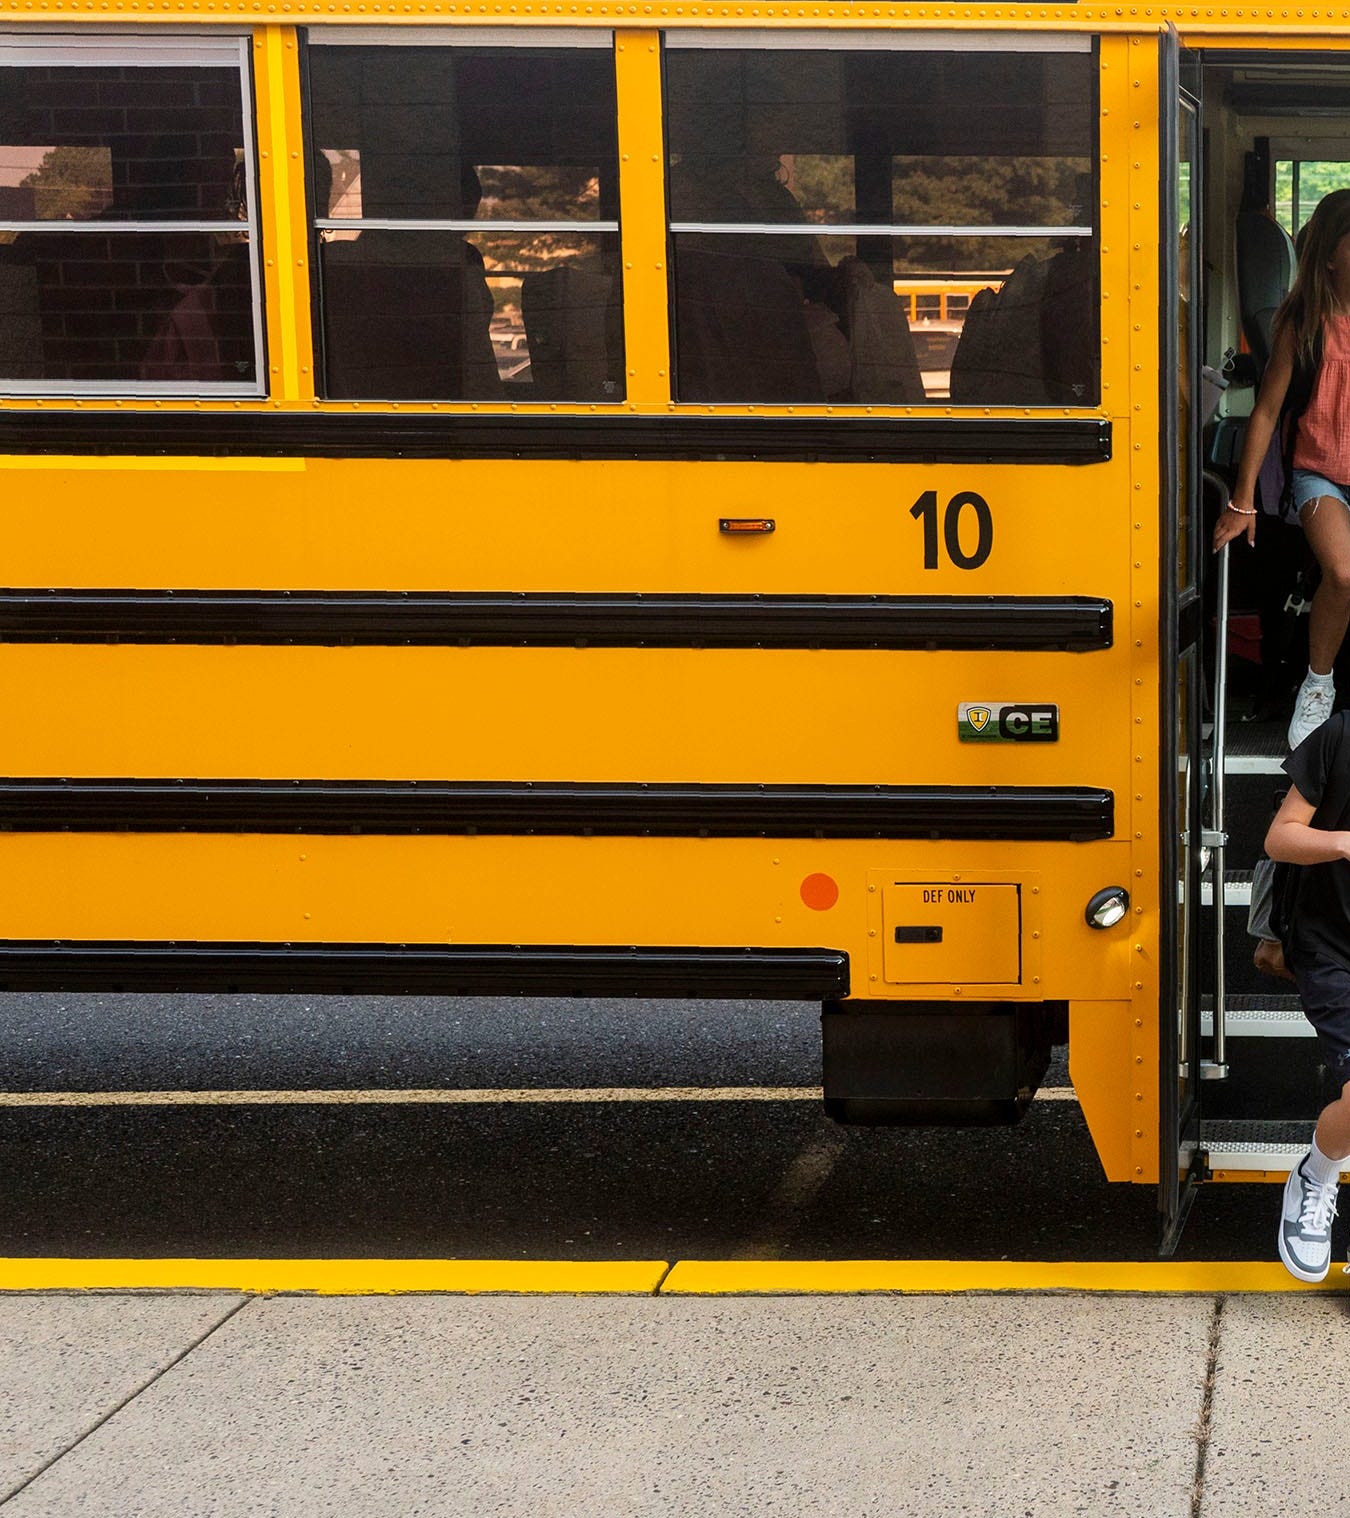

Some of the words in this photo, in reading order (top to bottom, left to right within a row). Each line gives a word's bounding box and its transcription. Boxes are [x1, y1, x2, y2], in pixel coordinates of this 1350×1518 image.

[908, 490, 993, 570] 10
[1005, 711, 1052, 734] CE
[923, 889, 943, 904] DEF
[947, 889, 976, 904] ONLY
